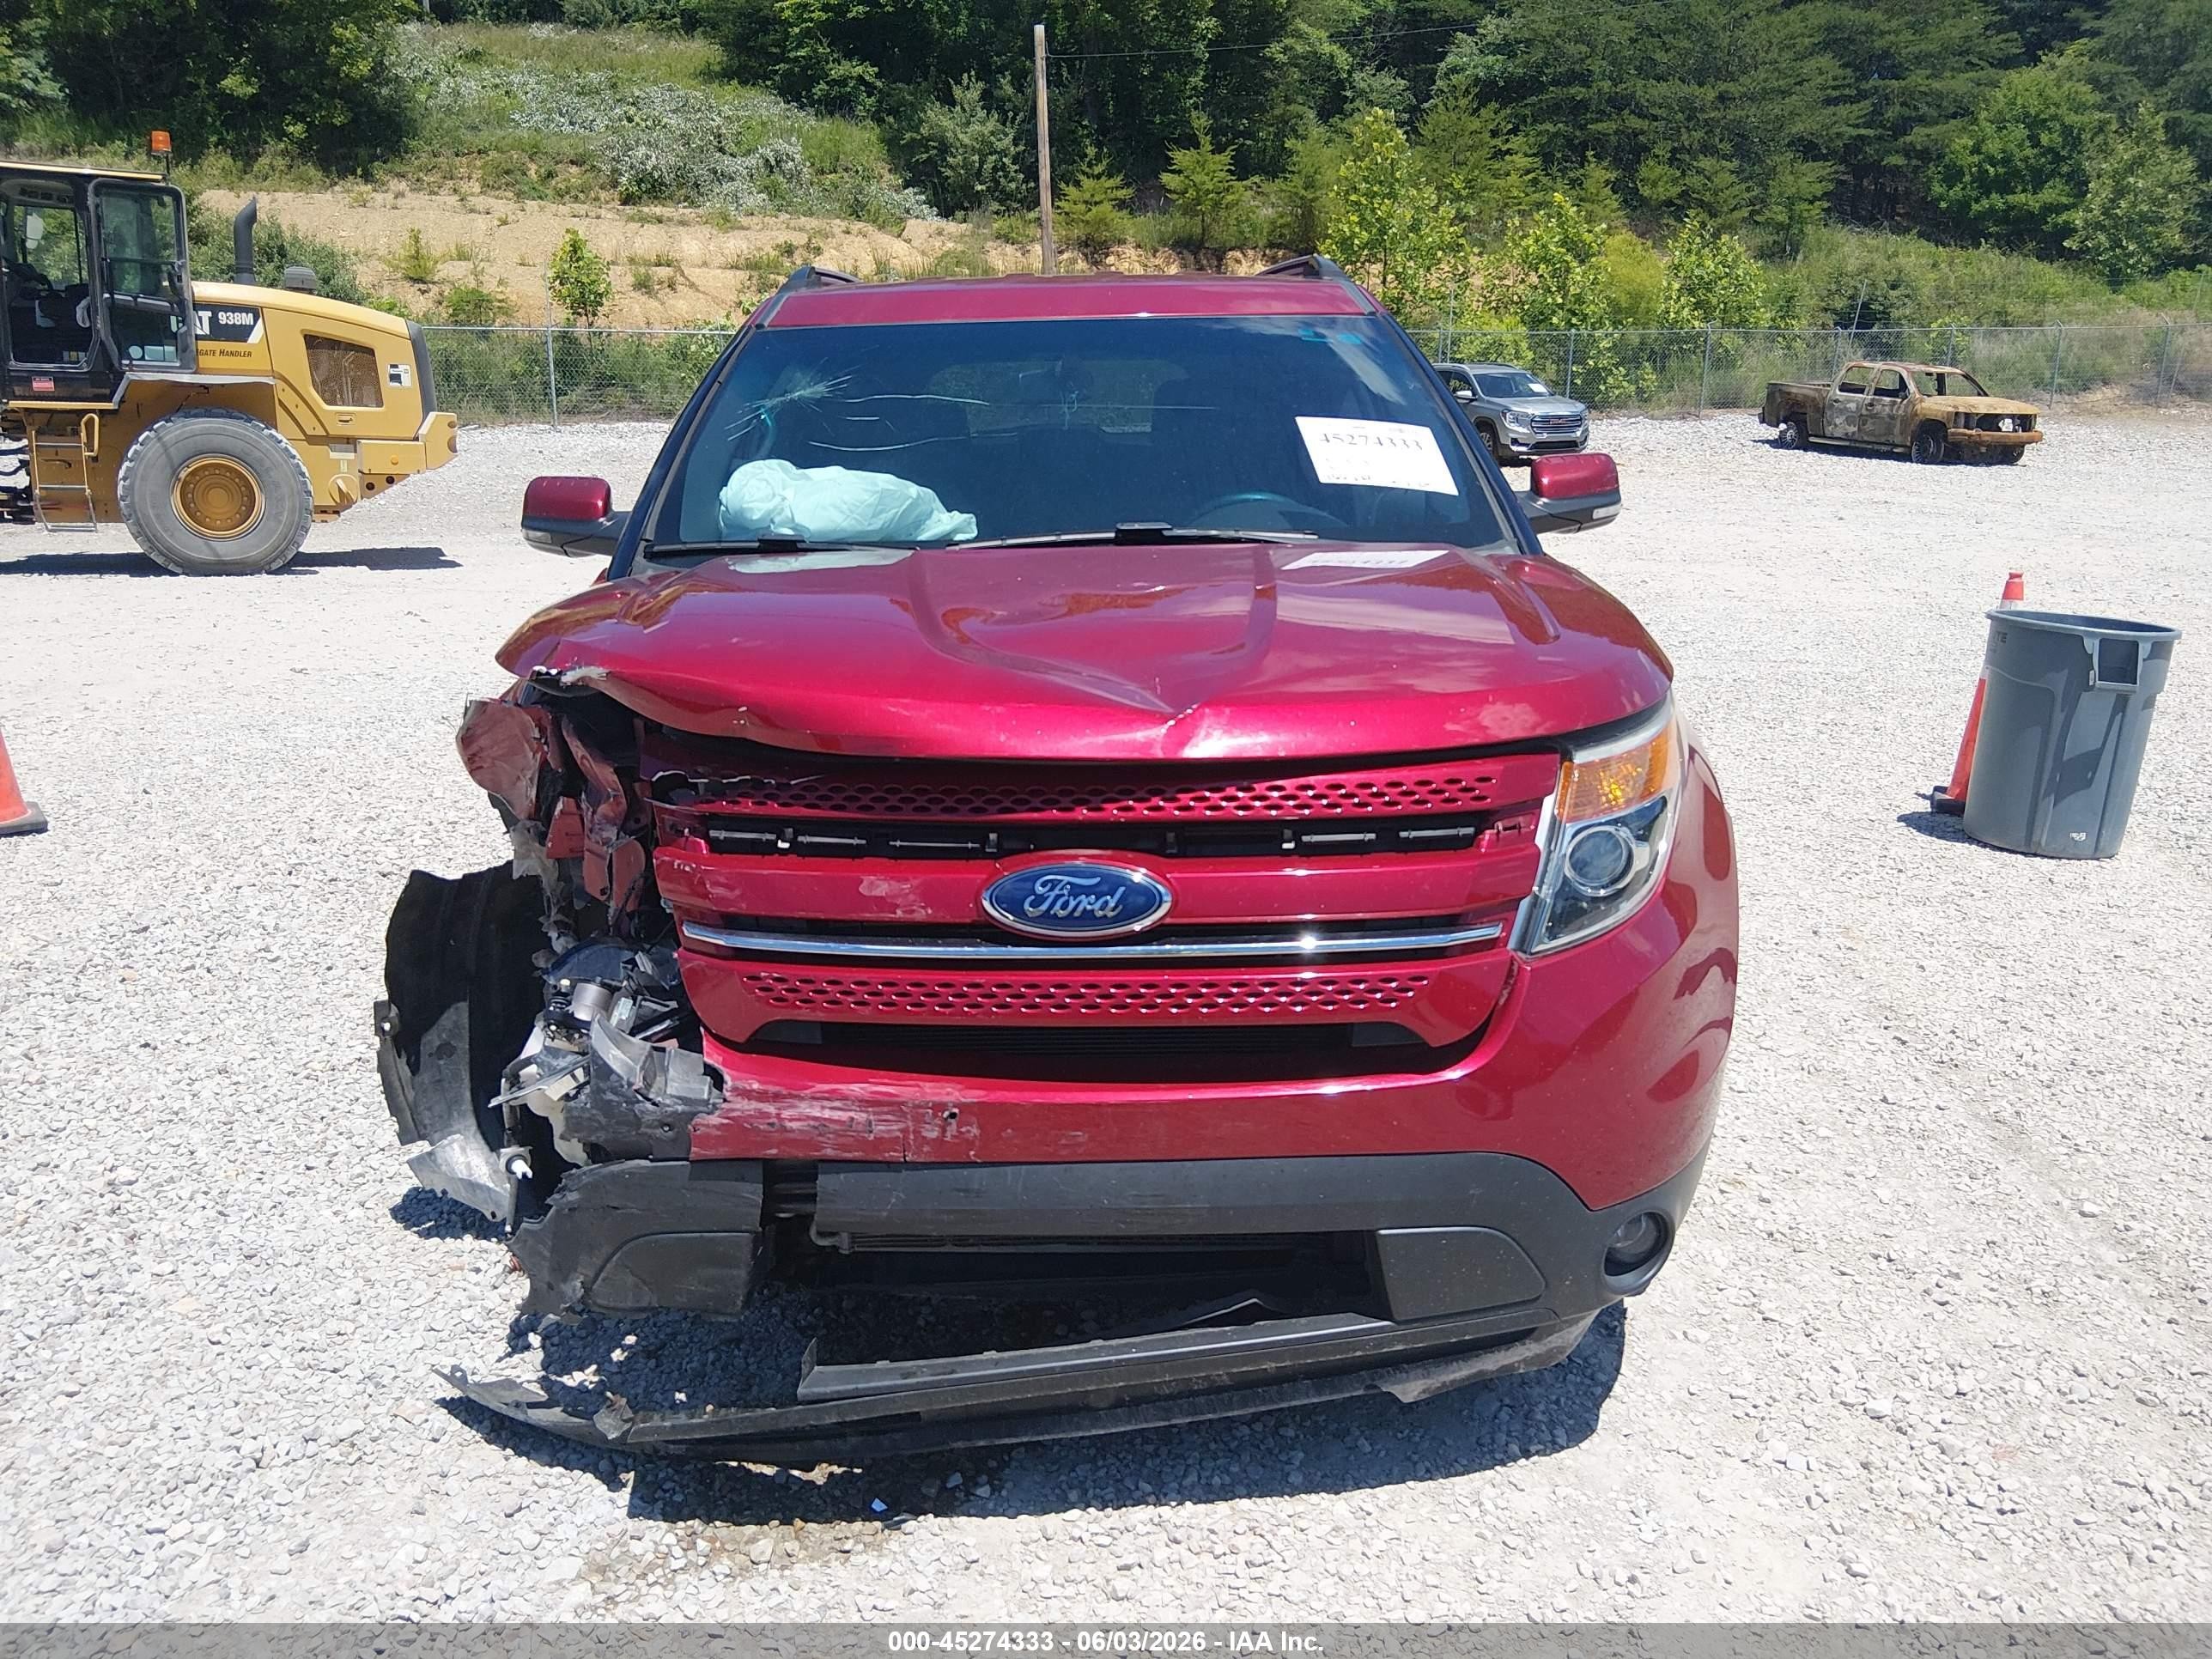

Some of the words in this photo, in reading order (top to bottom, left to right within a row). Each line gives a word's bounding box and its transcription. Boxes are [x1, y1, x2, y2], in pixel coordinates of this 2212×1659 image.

[218, 312, 253, 325] 938M
[218, 348, 252, 358] HANDLER
[1320, 433, 1423, 450] 45274333
[1024, 875, 1125, 918] Ford
